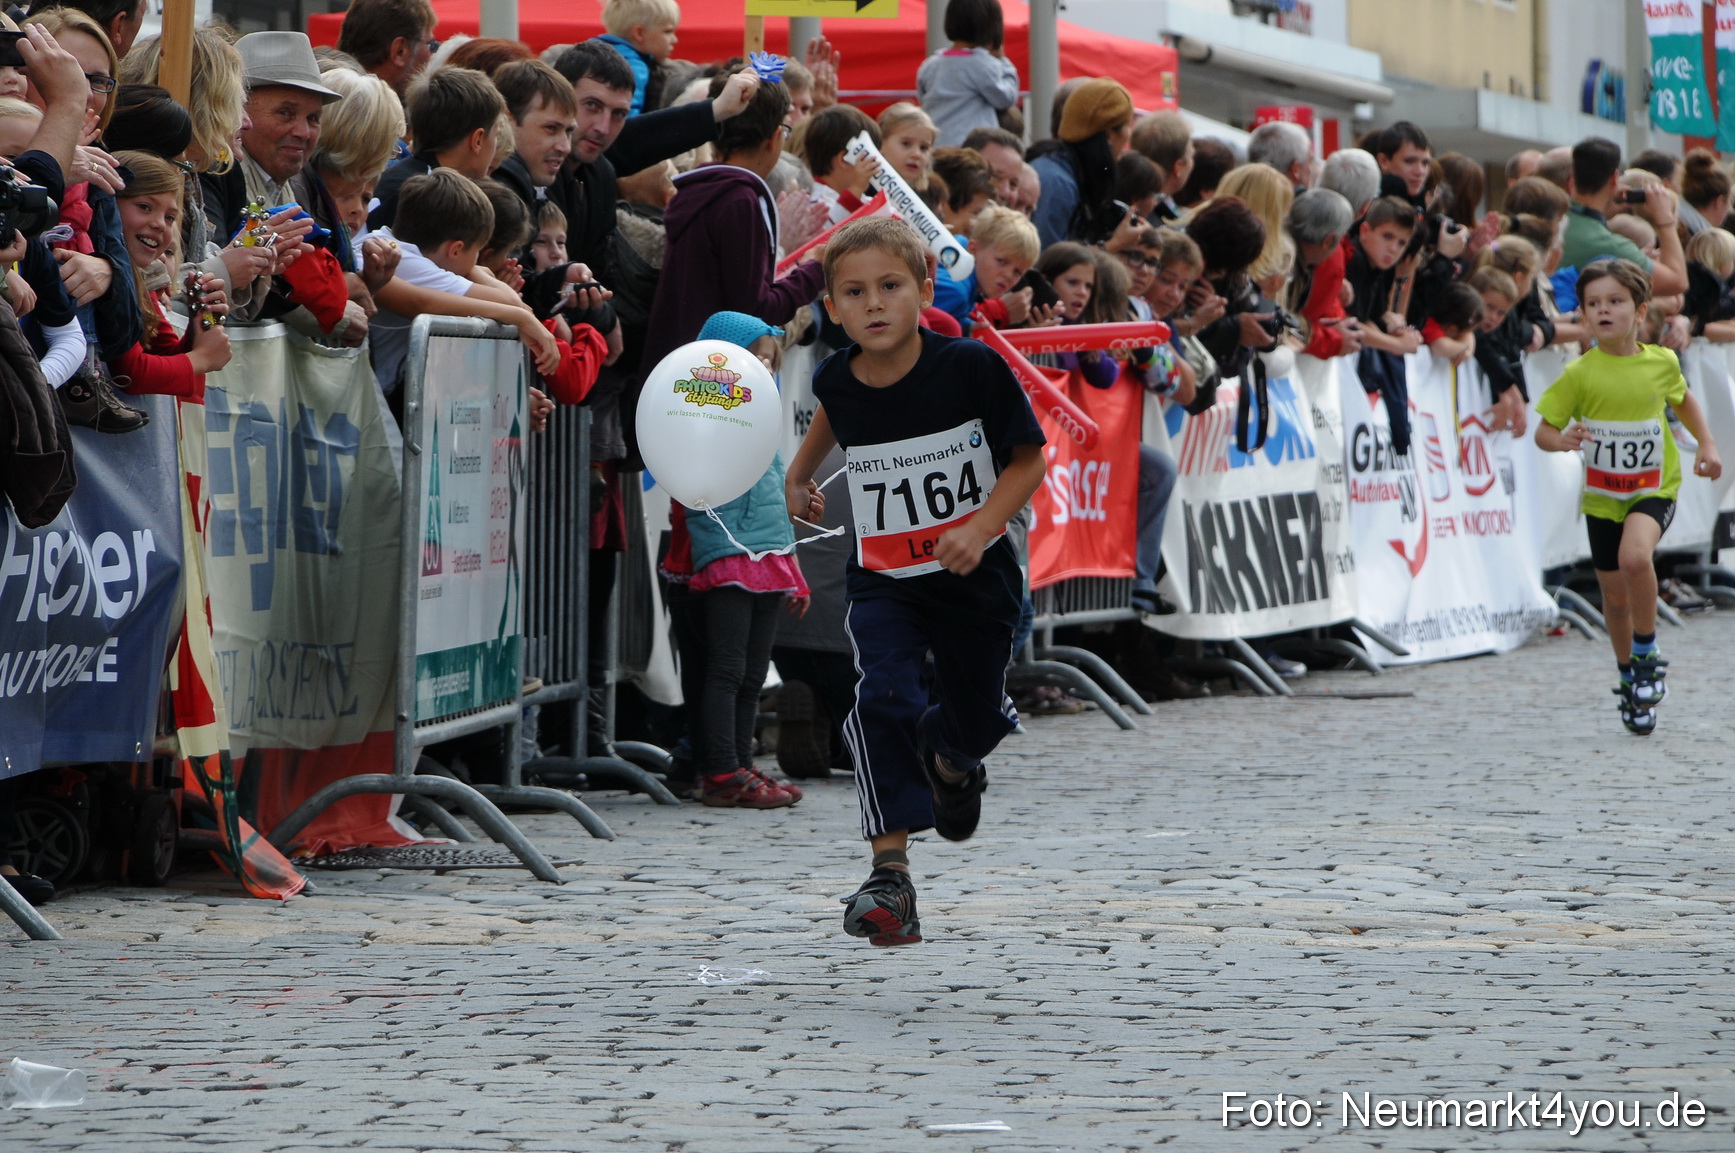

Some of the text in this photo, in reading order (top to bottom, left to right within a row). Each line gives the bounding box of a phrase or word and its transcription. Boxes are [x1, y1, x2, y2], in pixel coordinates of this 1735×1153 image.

[680, 410, 700, 418] lassen
[702, 412, 728, 422] Träume
[729, 417, 752, 428] steigen
[1609, 428, 1650, 437] Neumarkt
[848, 442, 965, 474] PARTL Neumarkt
[1594, 440, 1655, 468] 7132
[1604, 477, 1639, 489] Niklas
[862, 460, 982, 531] 7164
[908, 537, 939, 560] Le
